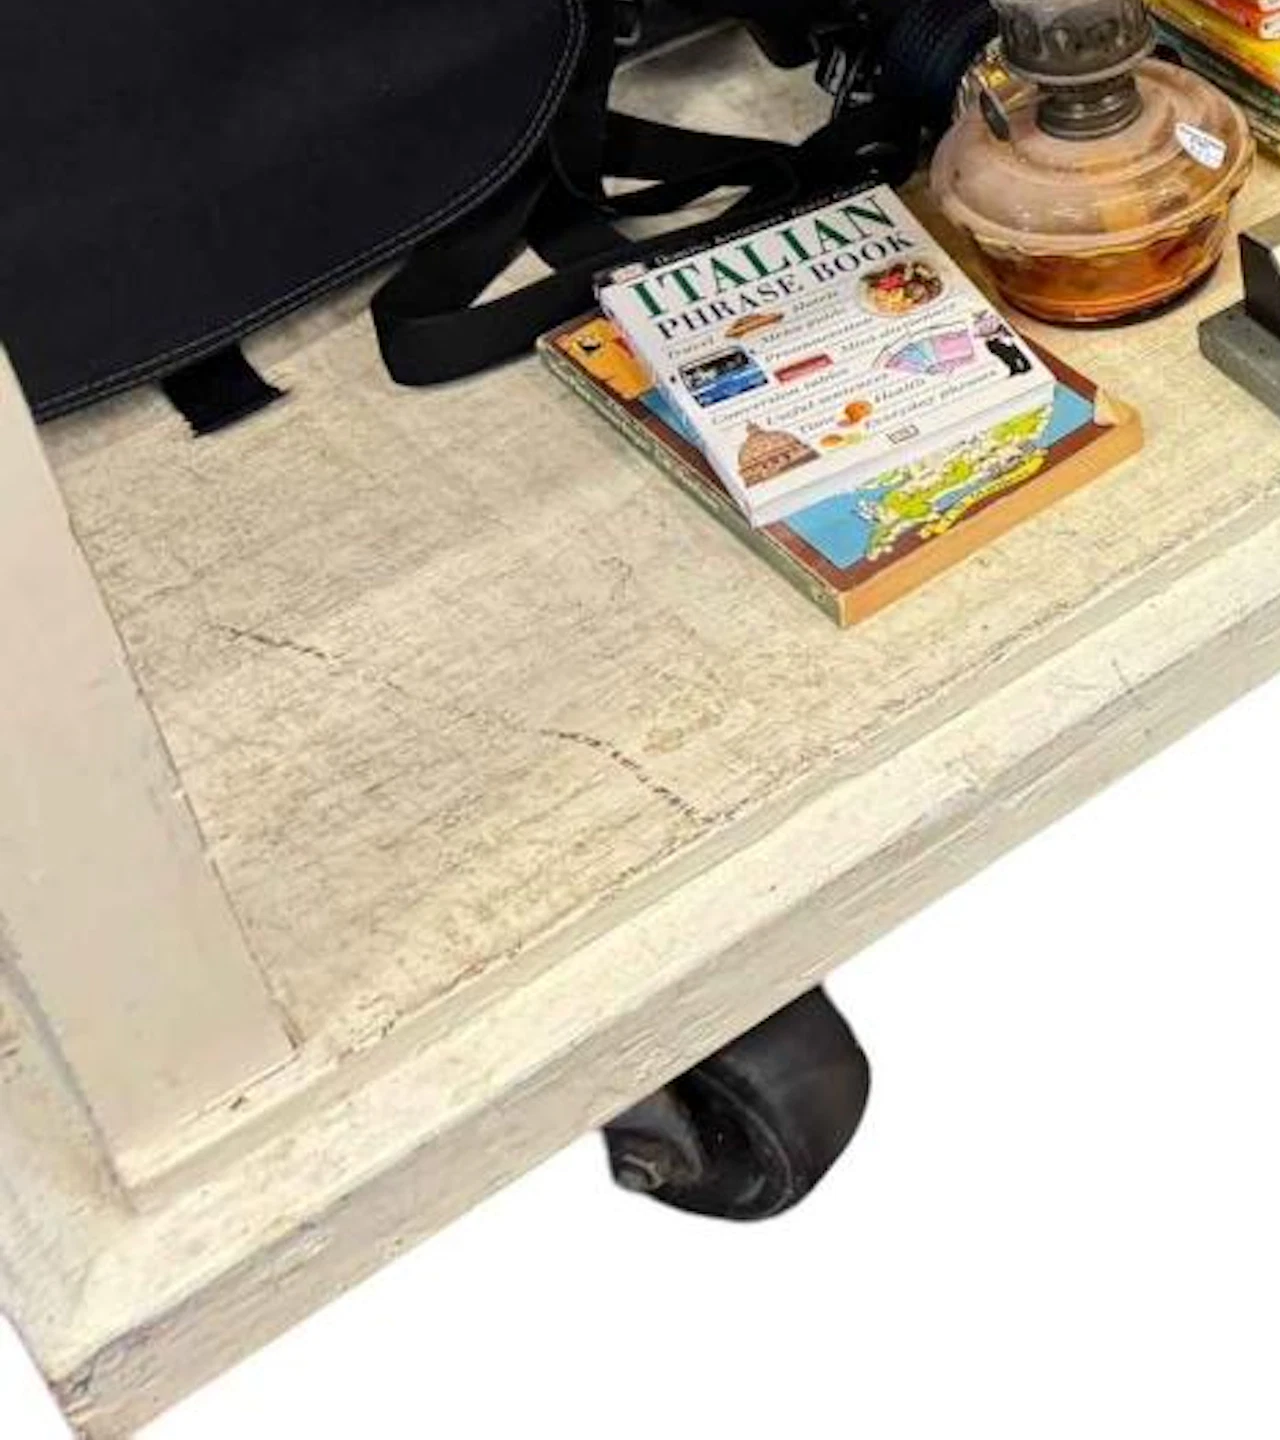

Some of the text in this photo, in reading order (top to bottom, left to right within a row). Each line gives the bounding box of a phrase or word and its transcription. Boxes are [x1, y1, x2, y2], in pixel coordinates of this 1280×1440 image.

[629, 193, 897, 320] ITALIAN
[657, 231, 915, 340] PHRASE BOOK
